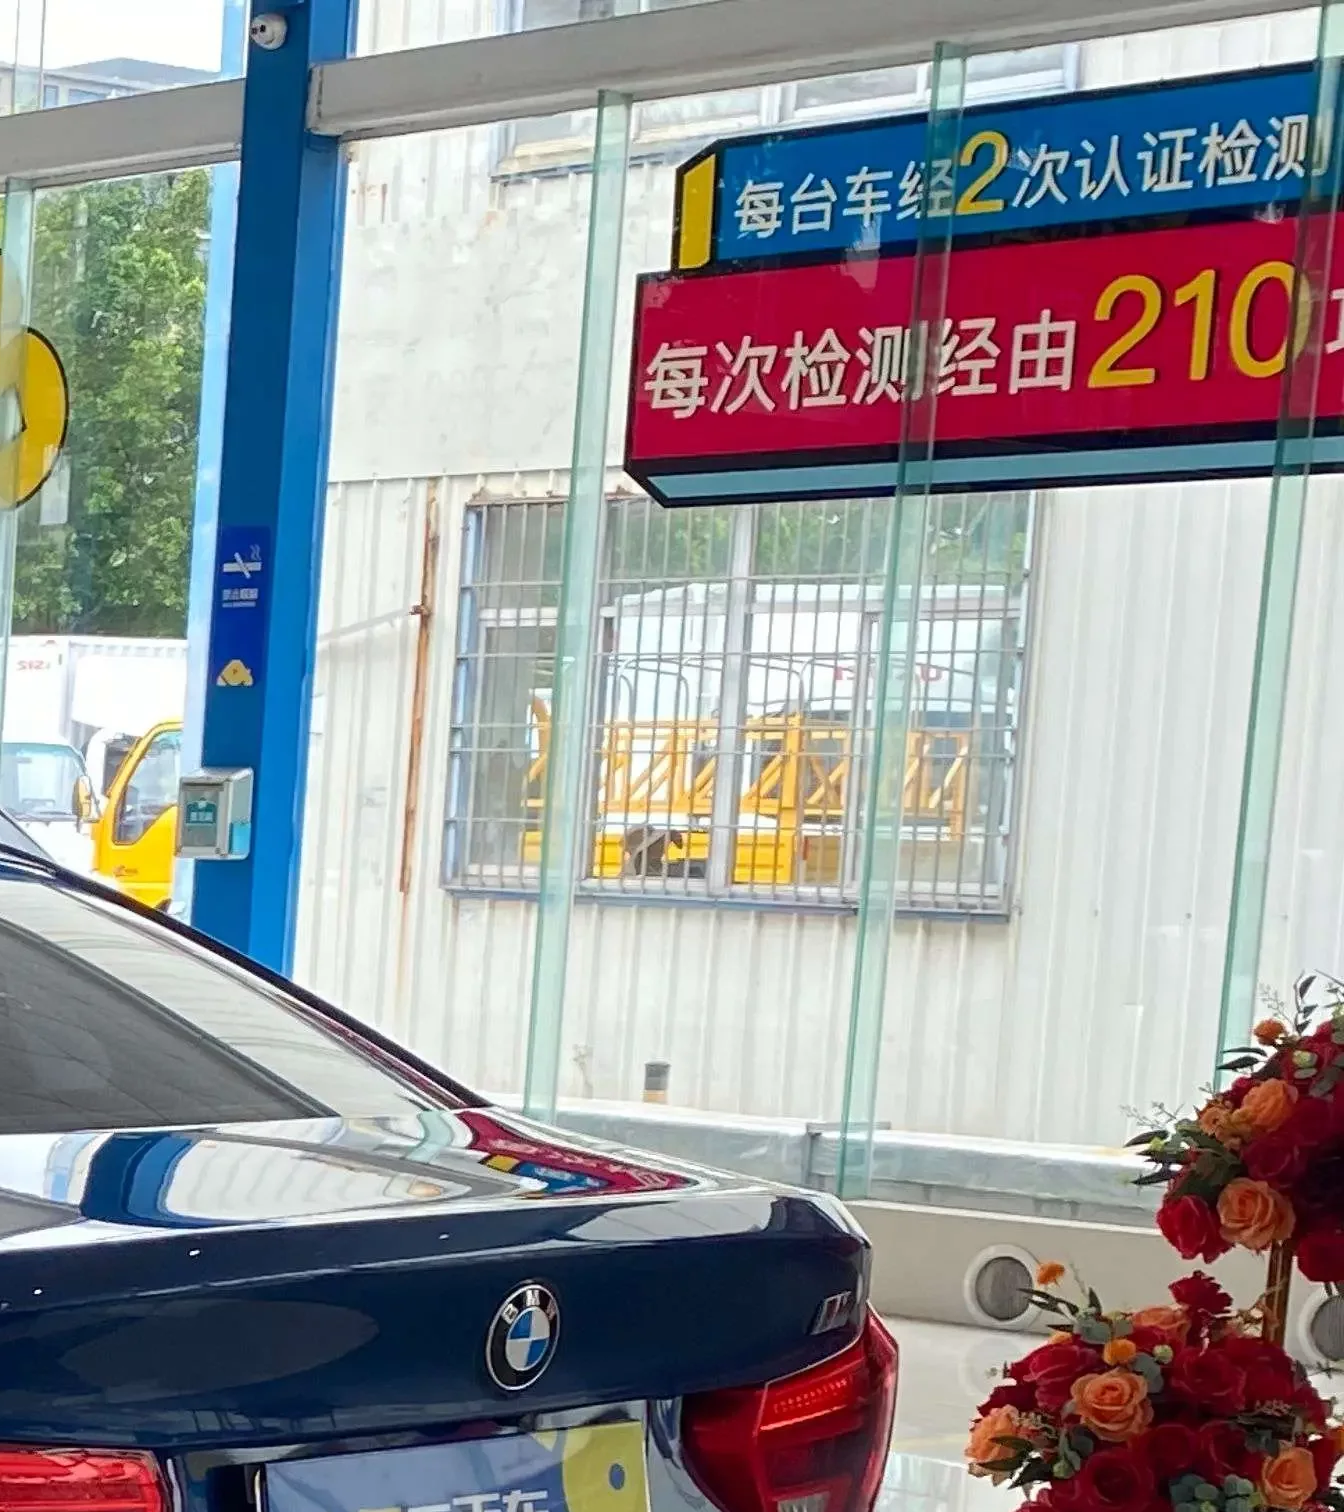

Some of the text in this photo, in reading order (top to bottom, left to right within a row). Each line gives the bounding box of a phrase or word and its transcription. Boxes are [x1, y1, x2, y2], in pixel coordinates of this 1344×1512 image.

[733, 110, 1332, 240] 每台车经2次认证检测
[500, 1288, 557, 1325] BMW
